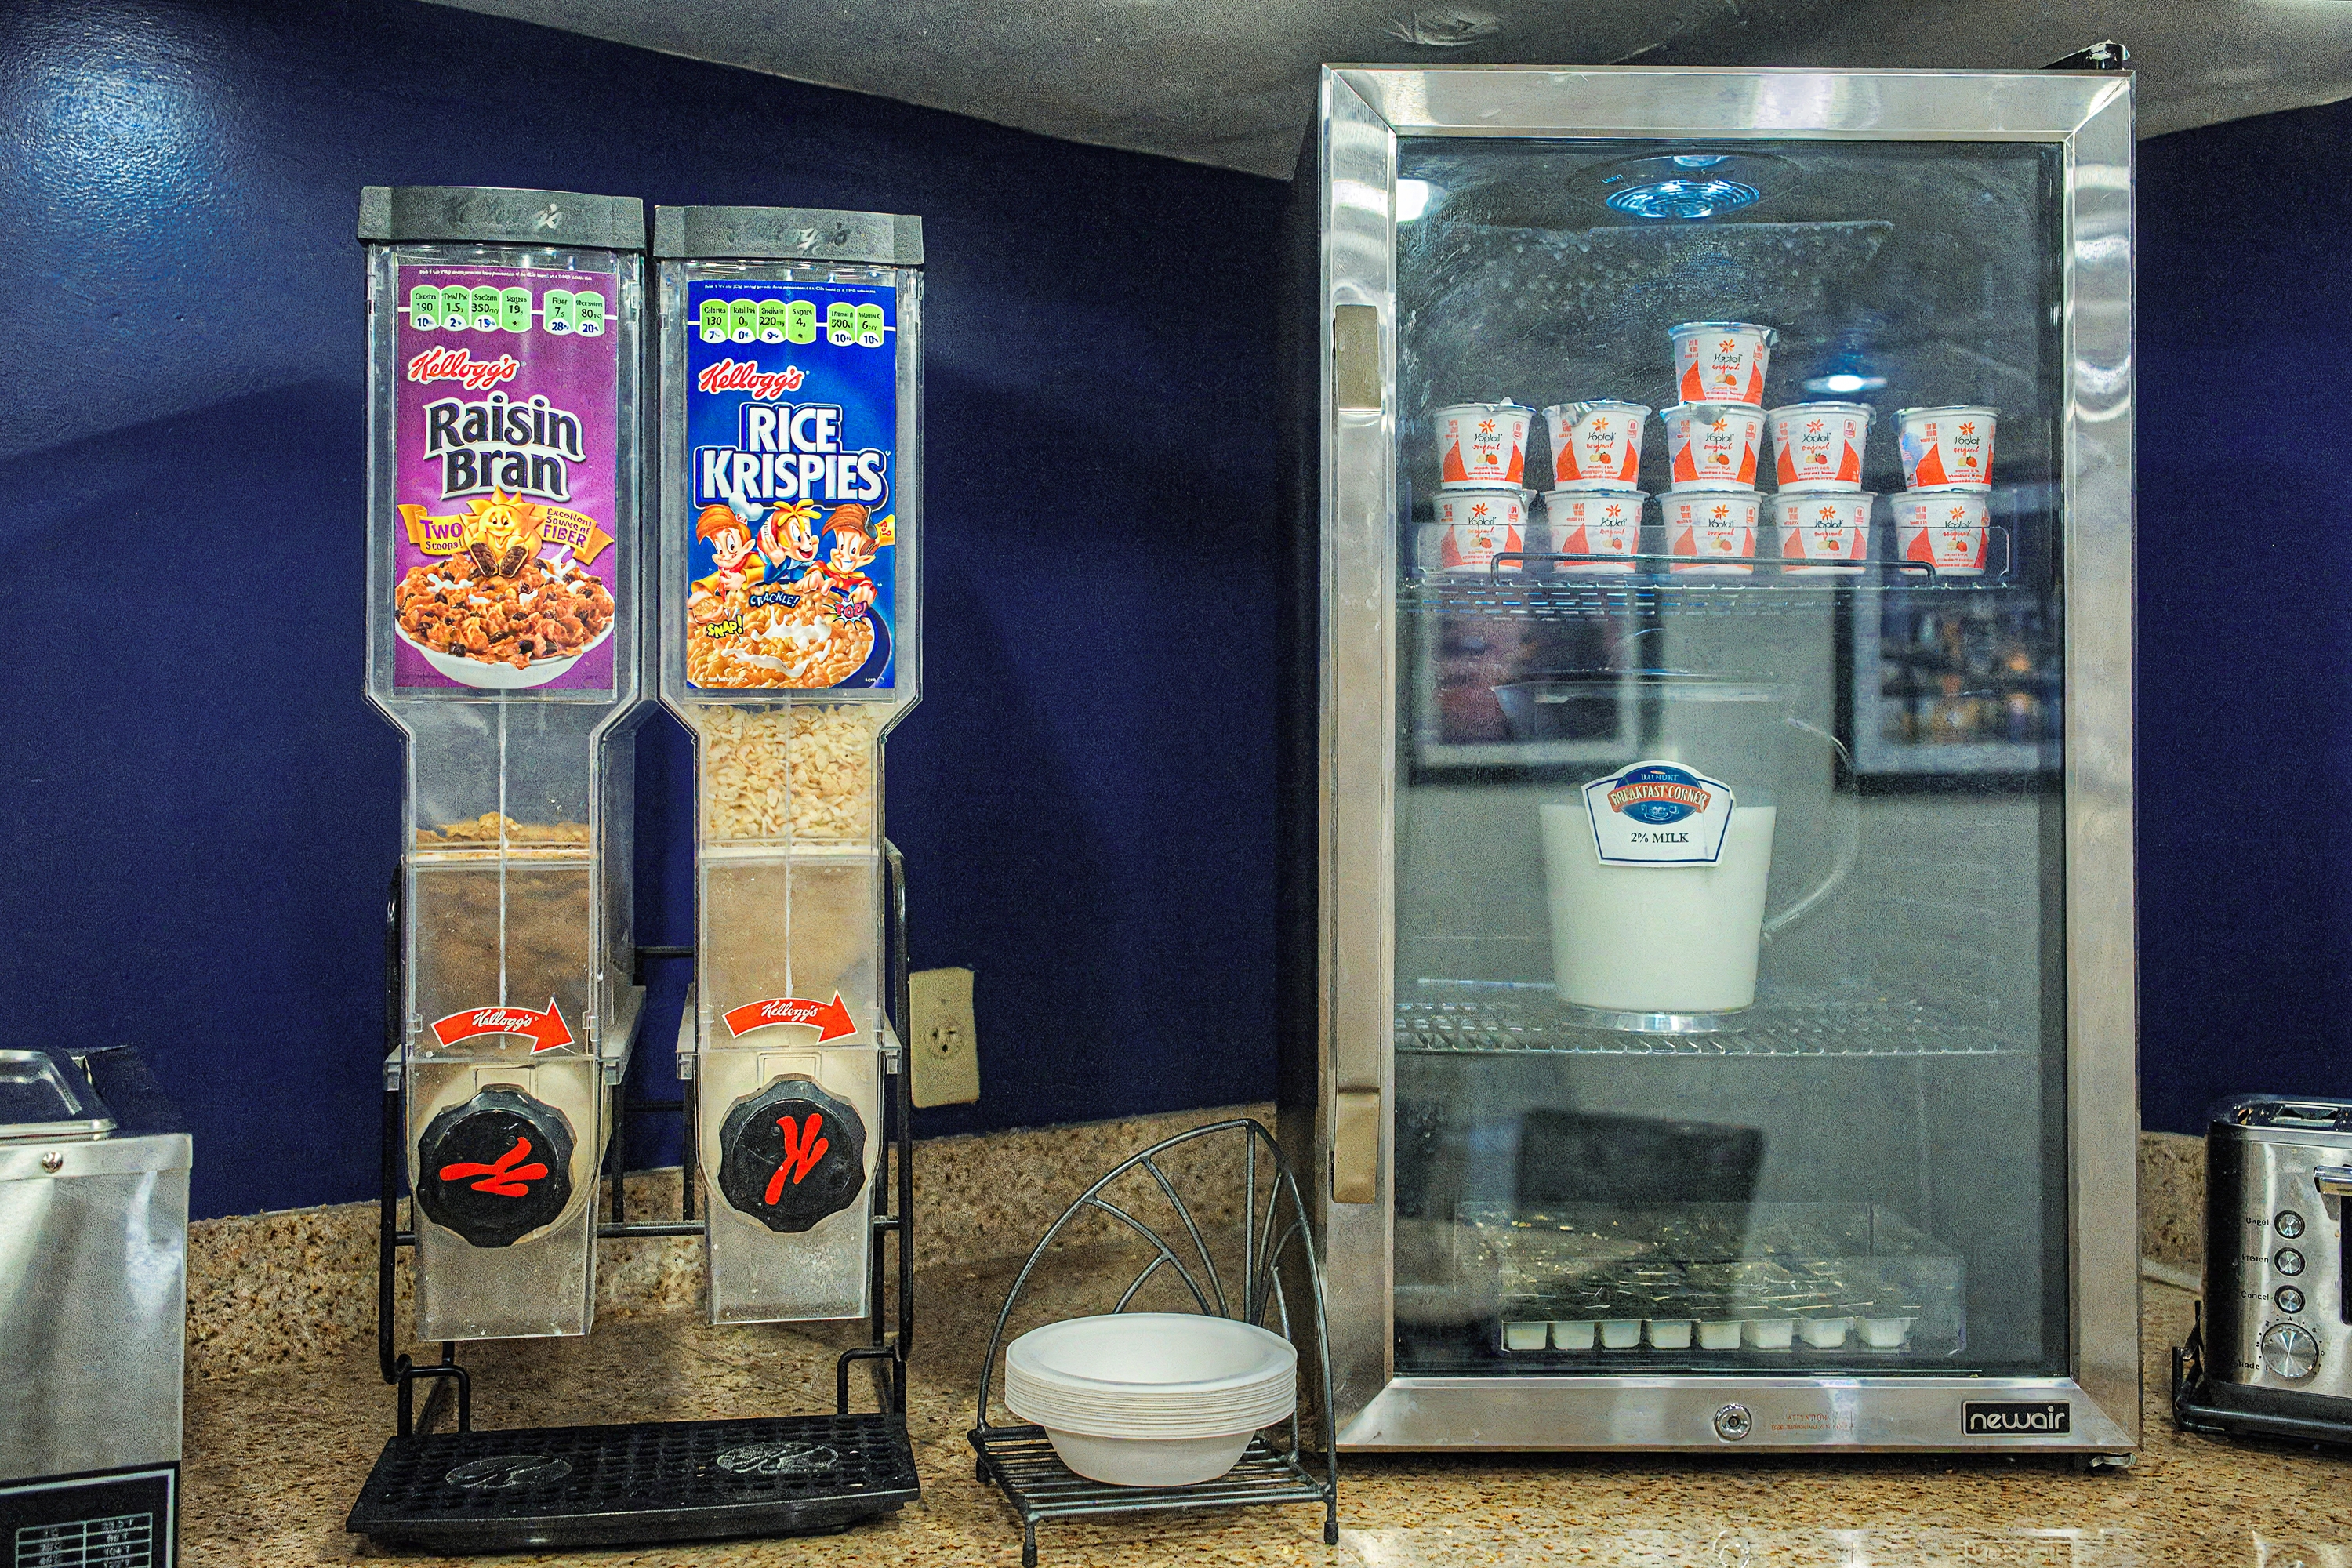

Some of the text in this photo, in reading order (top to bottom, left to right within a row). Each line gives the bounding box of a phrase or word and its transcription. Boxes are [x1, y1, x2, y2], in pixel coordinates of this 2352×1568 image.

[416, 303, 433, 311] 190
[706, 317, 722, 325] 130
[409, 348, 518, 388] Kellogg's
[700, 360, 804, 398] Kellogg's
[428, 394, 580, 457] Raisin
[749, 406, 837, 453] RICE
[445, 448, 565, 497] Bran
[702, 449, 883, 501] KRISPIES
[543, 524, 586, 548] FIBER
[750, 591, 800, 608] CRACKLE!
[707, 615, 743, 637] SNAP!
[1630, 832, 1689, 844] 2% MILK
[472, 1009, 534, 1032] Kellogg's
[760, 1000, 818, 1022] Kellogg's
[2235, 1360, 2260, 1370] hade
[1969, 1406, 2066, 1432] newair
